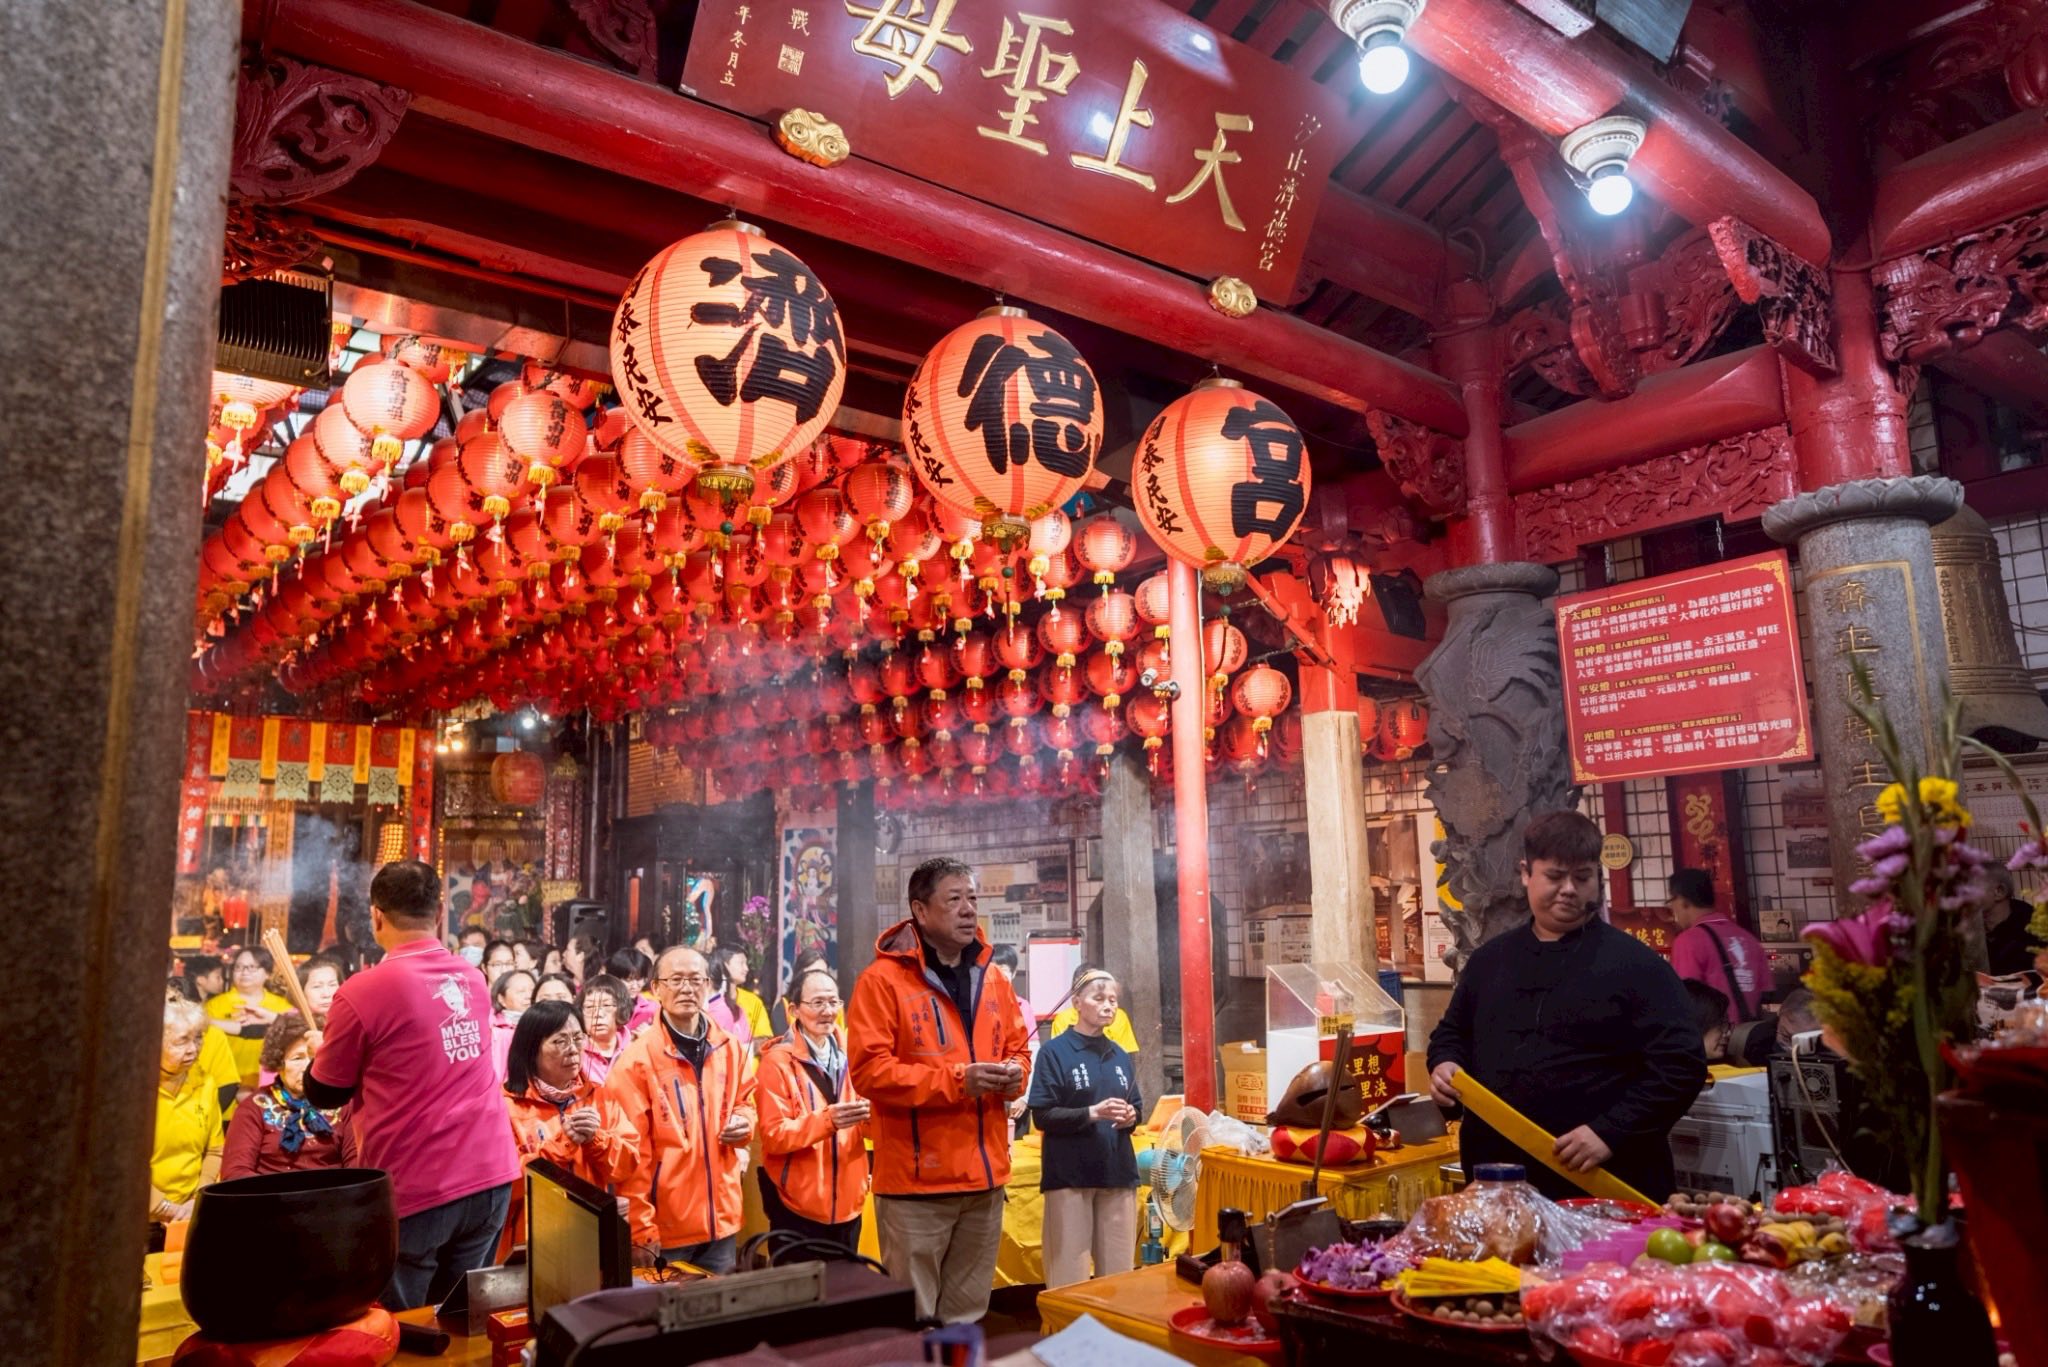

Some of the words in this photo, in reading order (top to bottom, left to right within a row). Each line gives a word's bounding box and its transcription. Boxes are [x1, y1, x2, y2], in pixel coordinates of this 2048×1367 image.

[845, 0, 1253, 231] 天上聖母
[1259, 113, 1322, 271] 汐止濟德宮
[687, 248, 847, 425] 濟
[1141, 416, 1183, 534] 國泰民安
[1221, 400, 1303, 542] 宮
[1578, 681, 1610, 695] 平安燈
[1582, 729, 1615, 742] 光明燈
[441, 1020, 479, 1040] MAZU
[443, 1032, 480, 1051] BLESS
[446, 1044, 480, 1064] YOU
